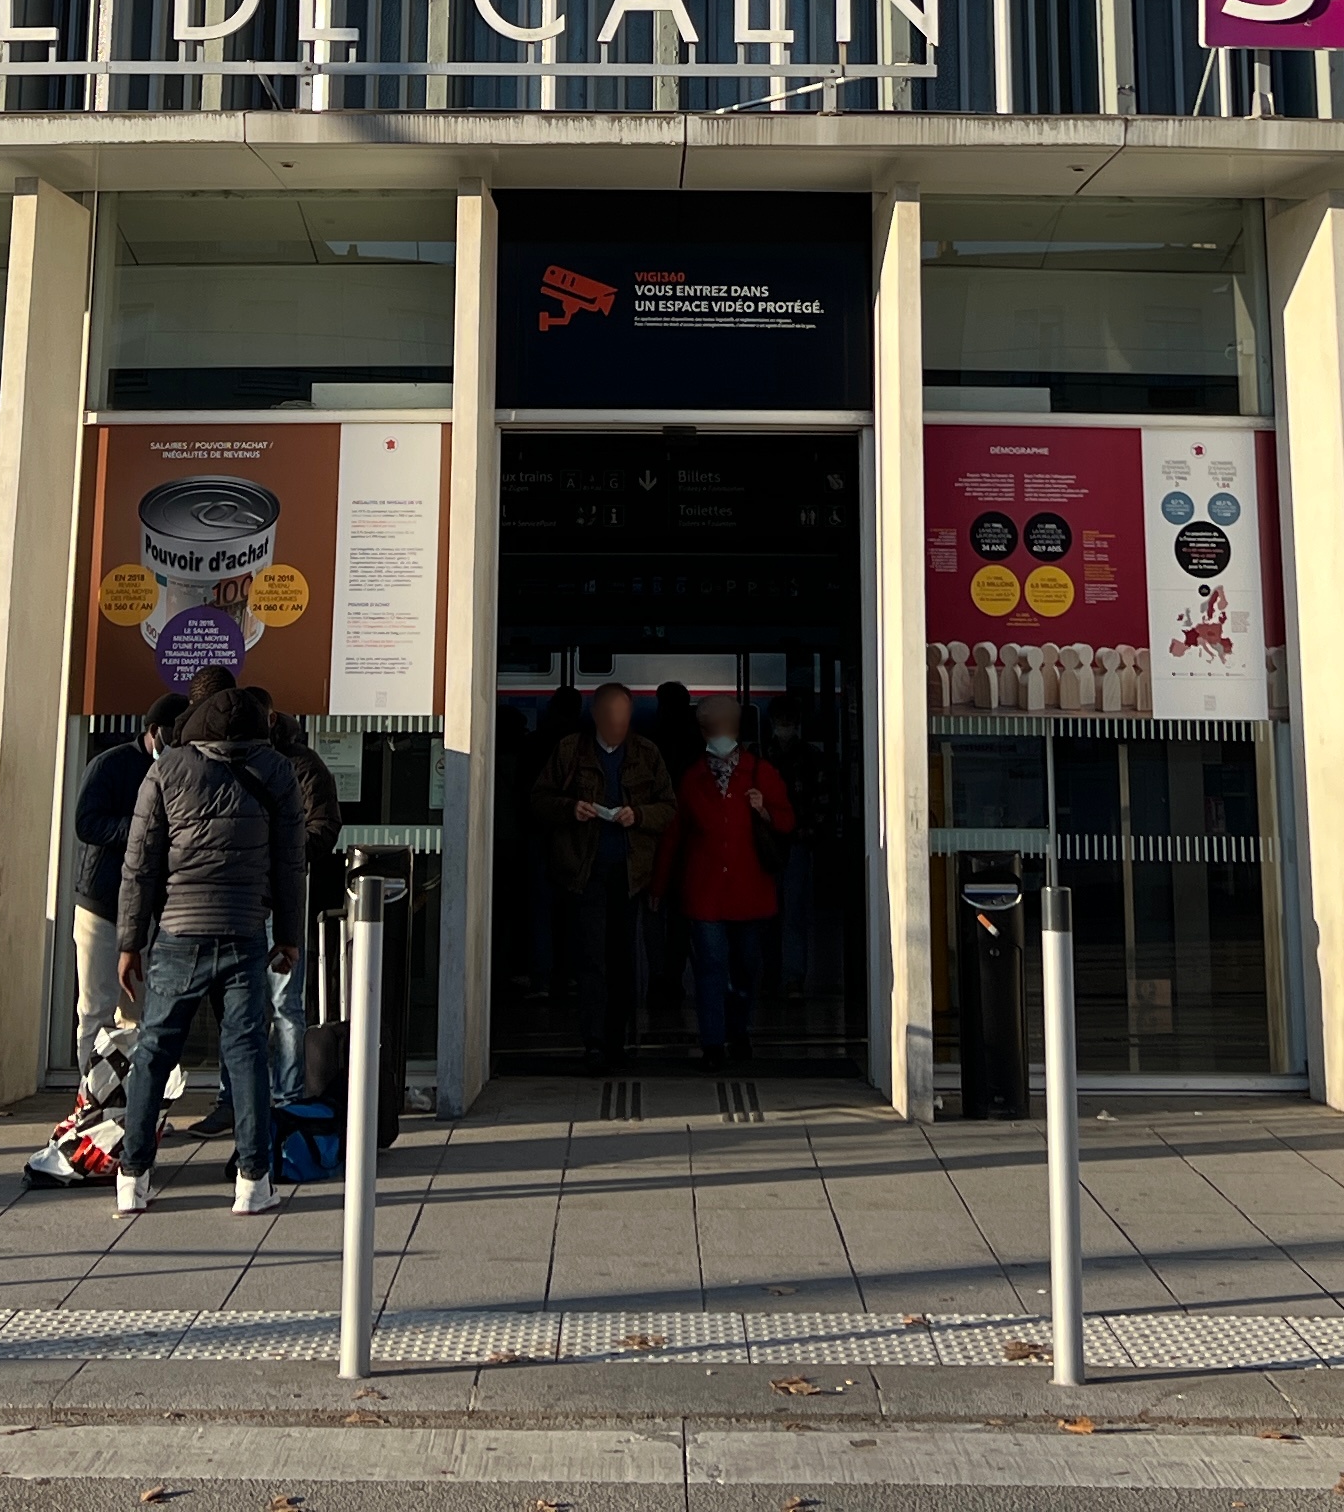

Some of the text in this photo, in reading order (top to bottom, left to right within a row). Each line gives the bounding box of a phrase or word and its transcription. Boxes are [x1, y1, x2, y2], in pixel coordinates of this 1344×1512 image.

[634, 272, 685, 282] VIGI360
[634, 285, 769, 297] VOUS ENTREZ DANS
[634, 299, 825, 313] UN ESPACE VIDÉO PROTÉGÉ.
[990, 446, 1049, 455] DÉMOGRAPHIE
[520, 470, 553, 482] trains
[678, 470, 721, 482] Billets
[679, 505, 732, 516] Toilettes
[145, 532, 269, 572] Pouvoir d'achat
[174, 673, 179, 681] 2
